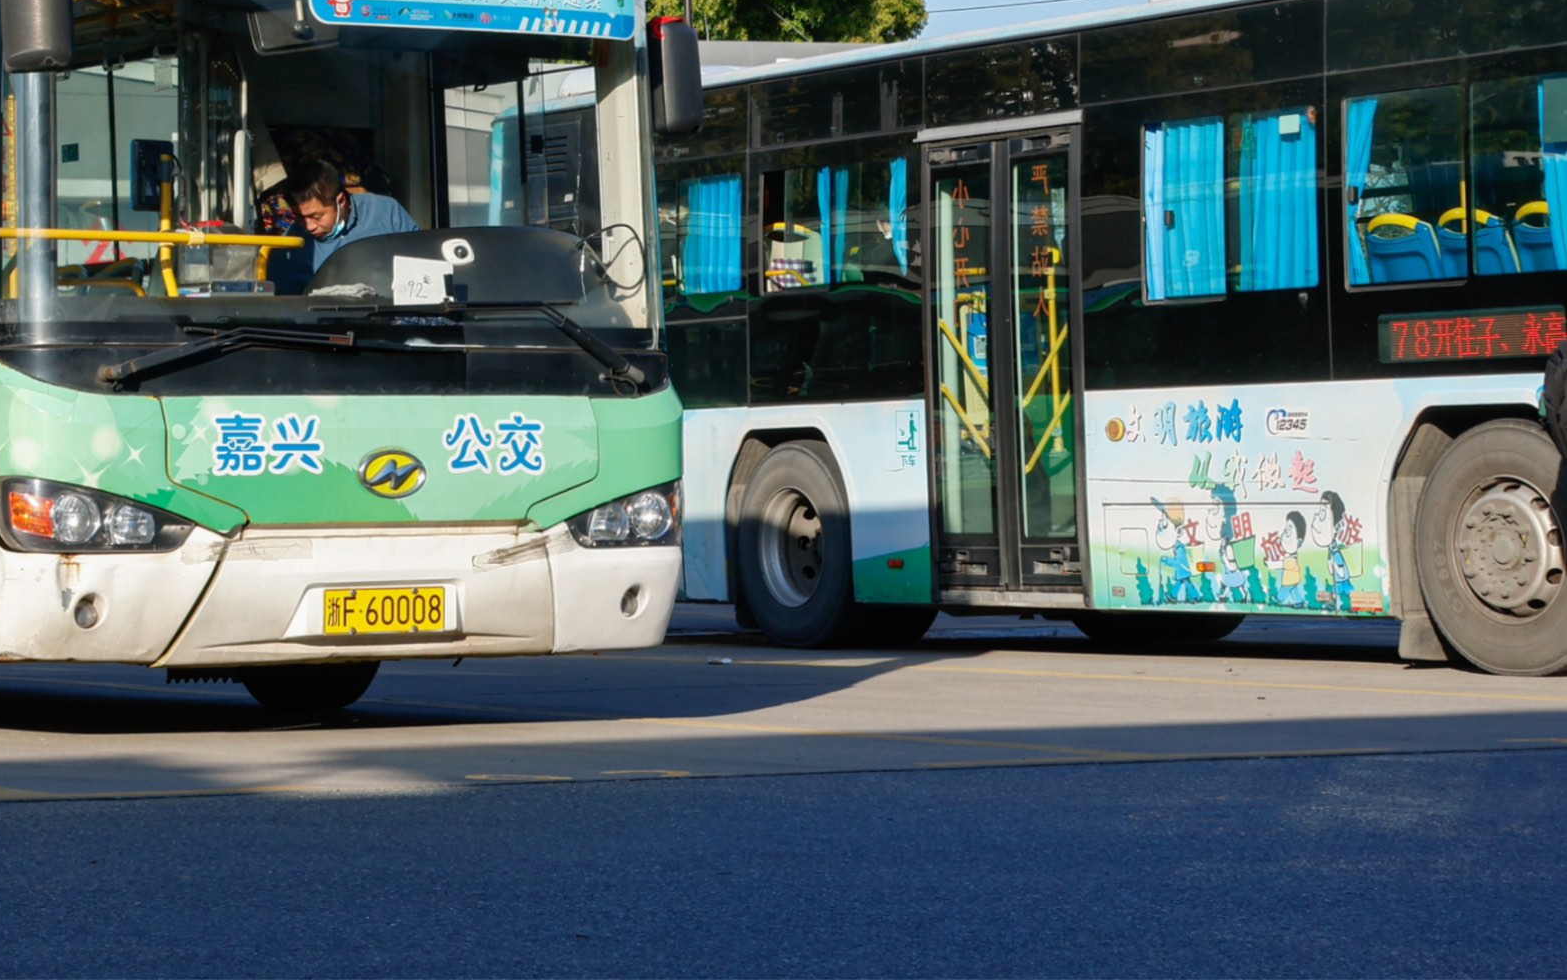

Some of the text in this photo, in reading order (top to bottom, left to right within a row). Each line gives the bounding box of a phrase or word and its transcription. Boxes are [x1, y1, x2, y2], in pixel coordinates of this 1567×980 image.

[1276, 418, 1308, 431] 12345
[213, 413, 544, 473] 嘉兴 公交
[900, 454, 917, 468] 下车
